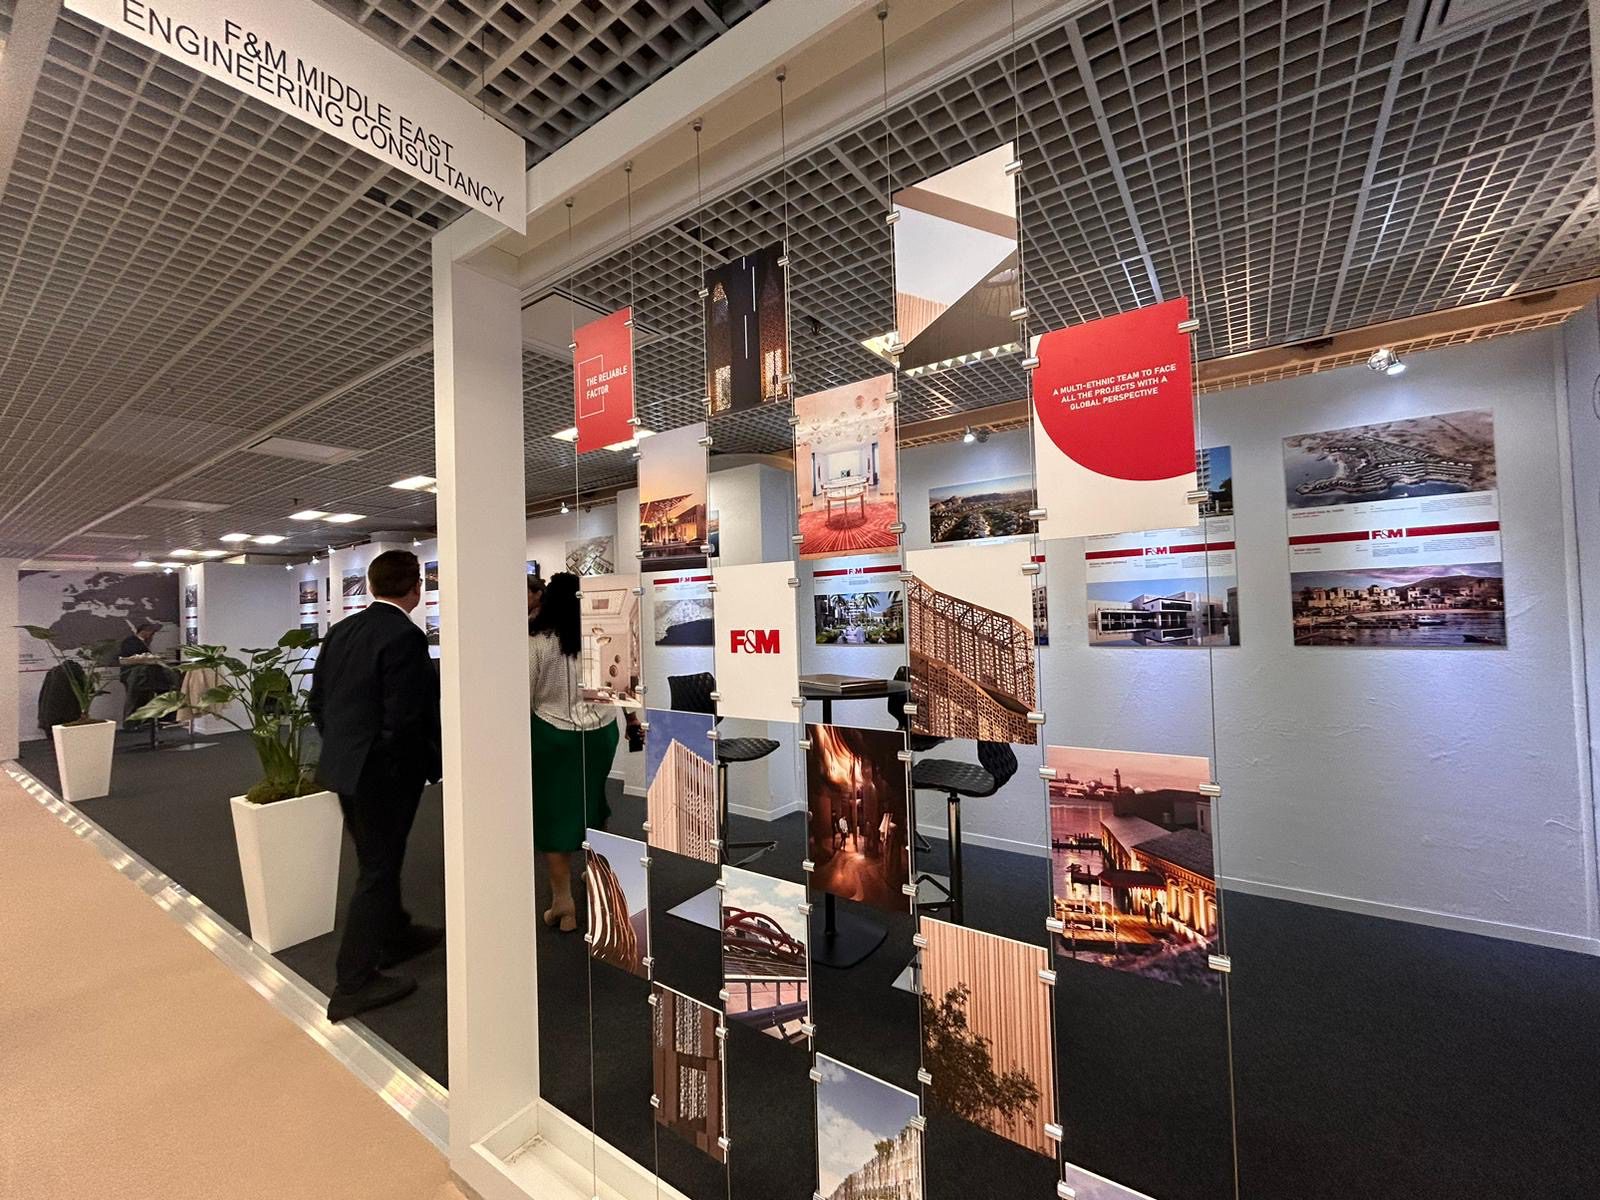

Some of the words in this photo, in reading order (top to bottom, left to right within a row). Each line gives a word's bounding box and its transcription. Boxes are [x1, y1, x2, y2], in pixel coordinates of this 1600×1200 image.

[224, 19, 287, 74] F&M
[297, 58, 391, 131] MIDDLE
[400, 116, 453, 162] EAST
[123, 0, 343, 127] ENGINEERING
[352, 116, 504, 212] CONSULTANCY
[586, 376, 598, 387] THE
[599, 365, 628, 383] RELIABLE
[1052, 388, 1059, 396] A
[1060, 376, 1115, 395] MULTI-ETHNIC
[1116, 371, 1140, 383] TEAM
[1141, 368, 1152, 377] TO
[1154, 363, 1177, 374] FACE
[586, 384, 609, 400] FACTOR
[1061, 394, 1076, 403] ALL
[1077, 390, 1093, 400] THE
[1094, 383, 1135, 396] PROJECTS
[1137, 376, 1159, 388] WITH
[1161, 375, 1168, 383] A
[1069, 398, 1101, 411] GLOBAL
[1102, 387, 1159, 404] PERSPECTIVE
[1371, 528, 1404, 540] F&M
[730, 629, 780, 654] F&M
